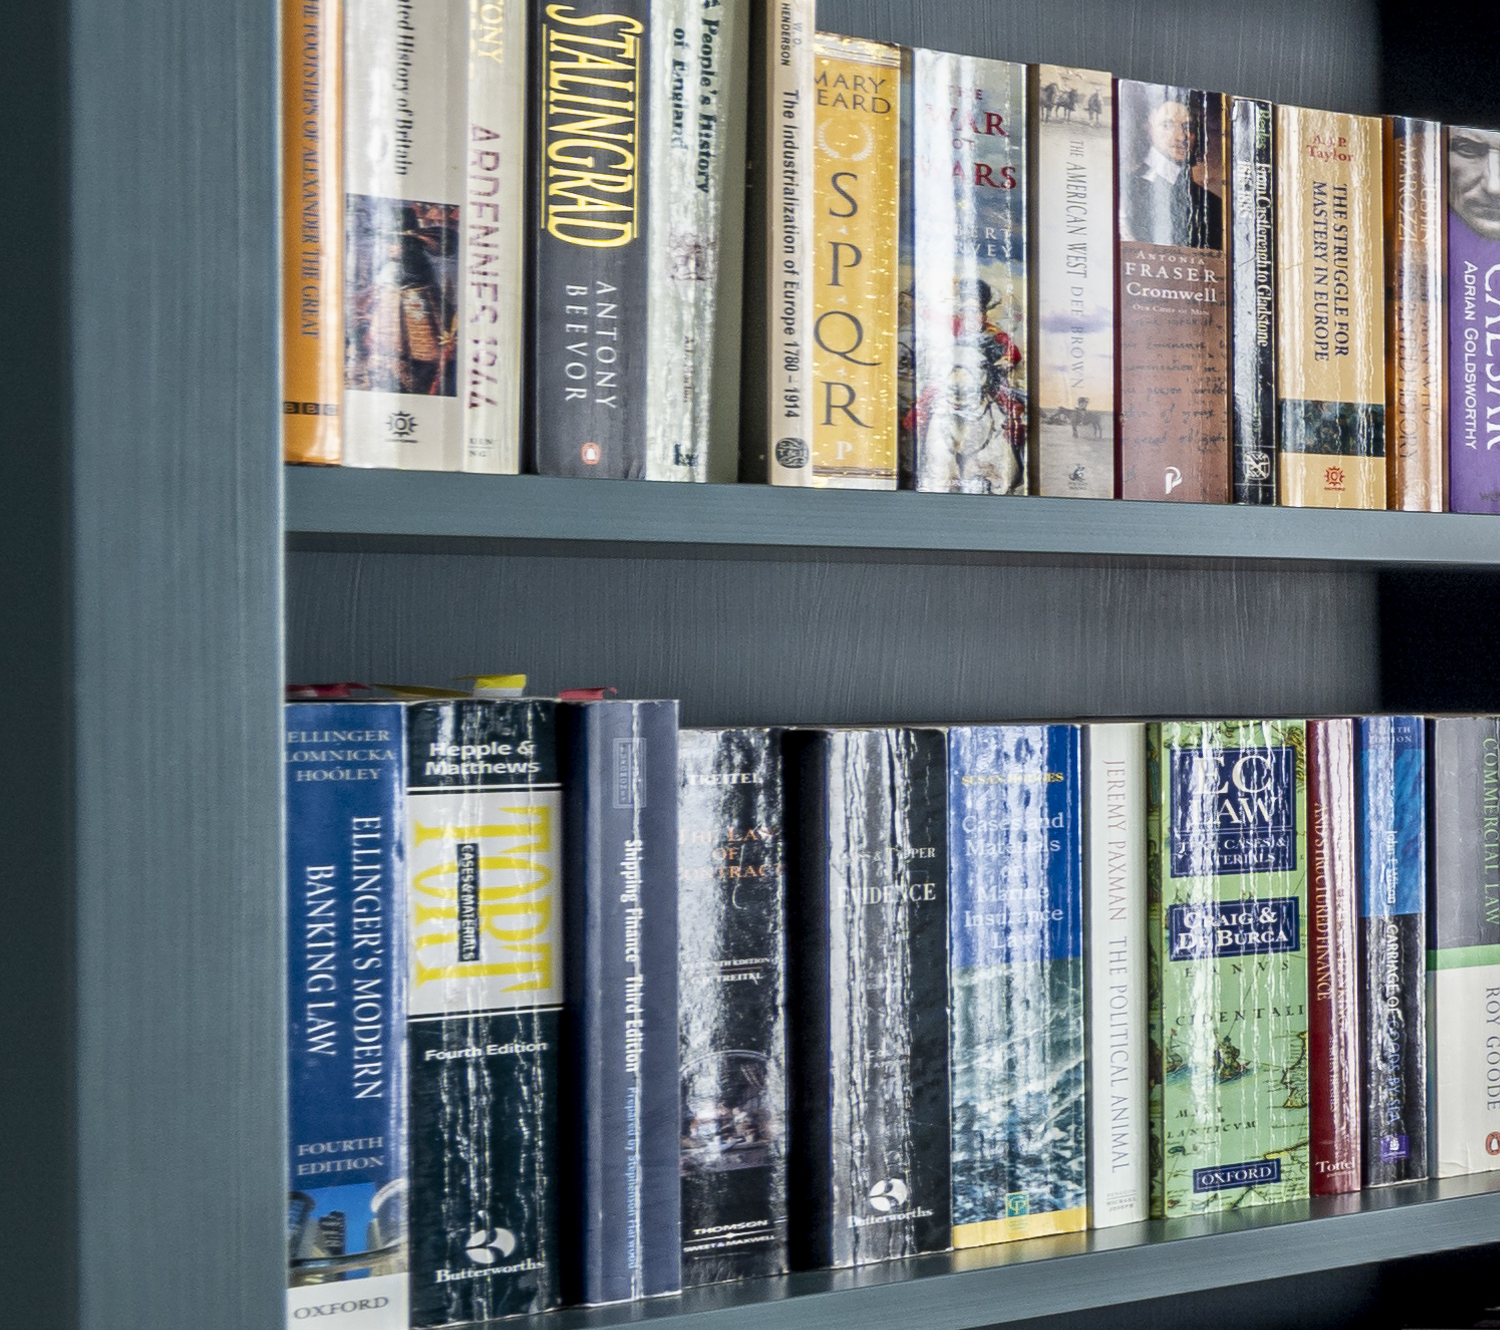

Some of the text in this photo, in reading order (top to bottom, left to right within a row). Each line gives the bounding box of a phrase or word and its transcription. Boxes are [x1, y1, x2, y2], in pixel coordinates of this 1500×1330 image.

[780, 2, 791, 67] HENDERSON
[545, 4, 645, 249] STALINGRAD
[780, 90, 801, 419] The Industrialization of Europe 1780 1914
[1126, 280, 1216, 302] Cromwell
[1313, 180, 1330, 361] MASTERY IN EUROPE
[1332, 183, 1348, 356] THE STRUGGLE FOR
[565, 284, 589, 401] BEEVOR
[595, 280, 619, 409] ANTONY
[1463, 261, 1477, 450] ADRIAN GOLDSWORTHY
[413, 806, 552, 993] TORT
[621, 839, 644, 963] Shipping Finance
[1104, 760, 1127, 921] JEREMY PAXMAN
[1482, 737, 1500, 924] COMMERCIAL LAW
[306, 865, 335, 1056] BANKING LAW
[353, 978, 383, 1099] MODERN
[624, 974, 644, 1073] Third Edition
[1485, 986, 1500, 1024] ROY
[1109, 938, 1129, 1174] THE POLITICAL ANIMAL
[1200, 1163, 1273, 1187] OXFORD
